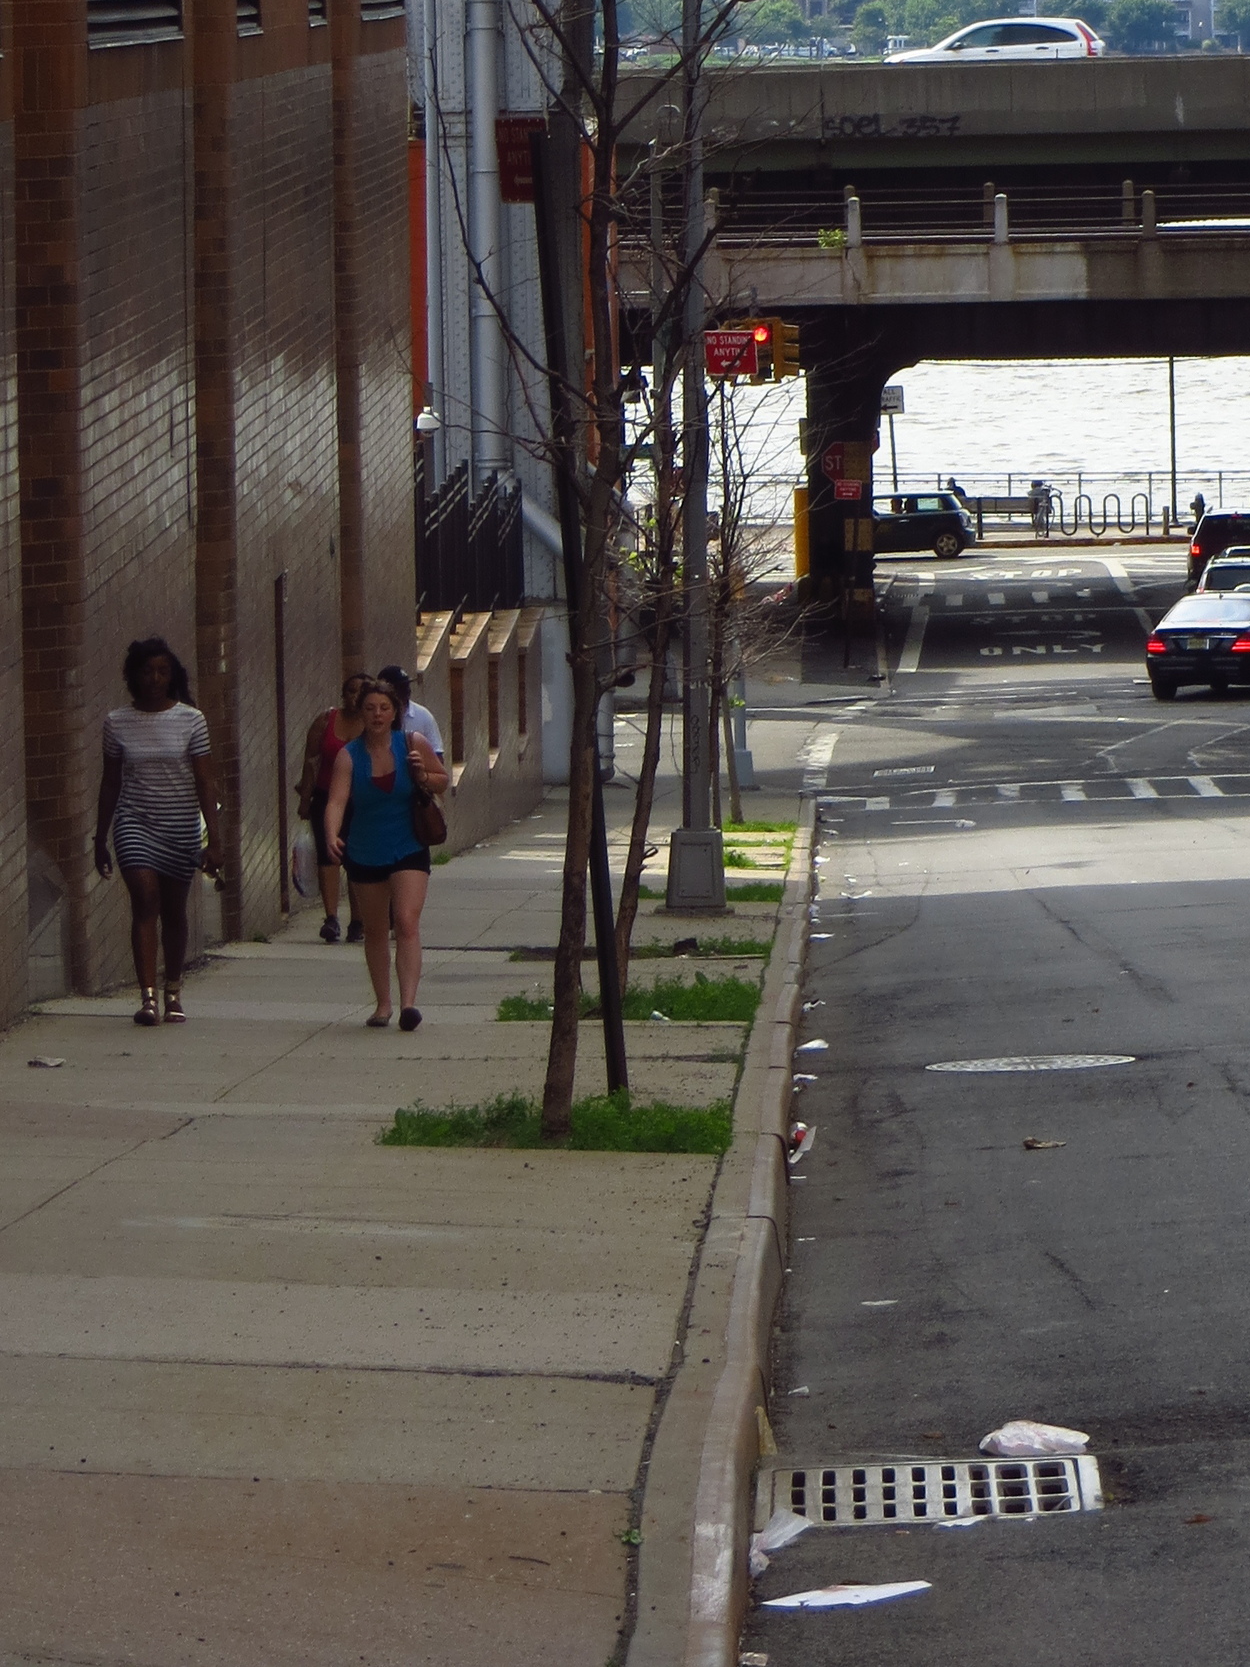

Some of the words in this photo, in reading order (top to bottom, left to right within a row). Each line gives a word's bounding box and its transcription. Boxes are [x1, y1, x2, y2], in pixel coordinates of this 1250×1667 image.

[706, 336, 717, 344] NO
[825, 455, 842, 471] ST
[979, 643, 1105, 656] ONLY
